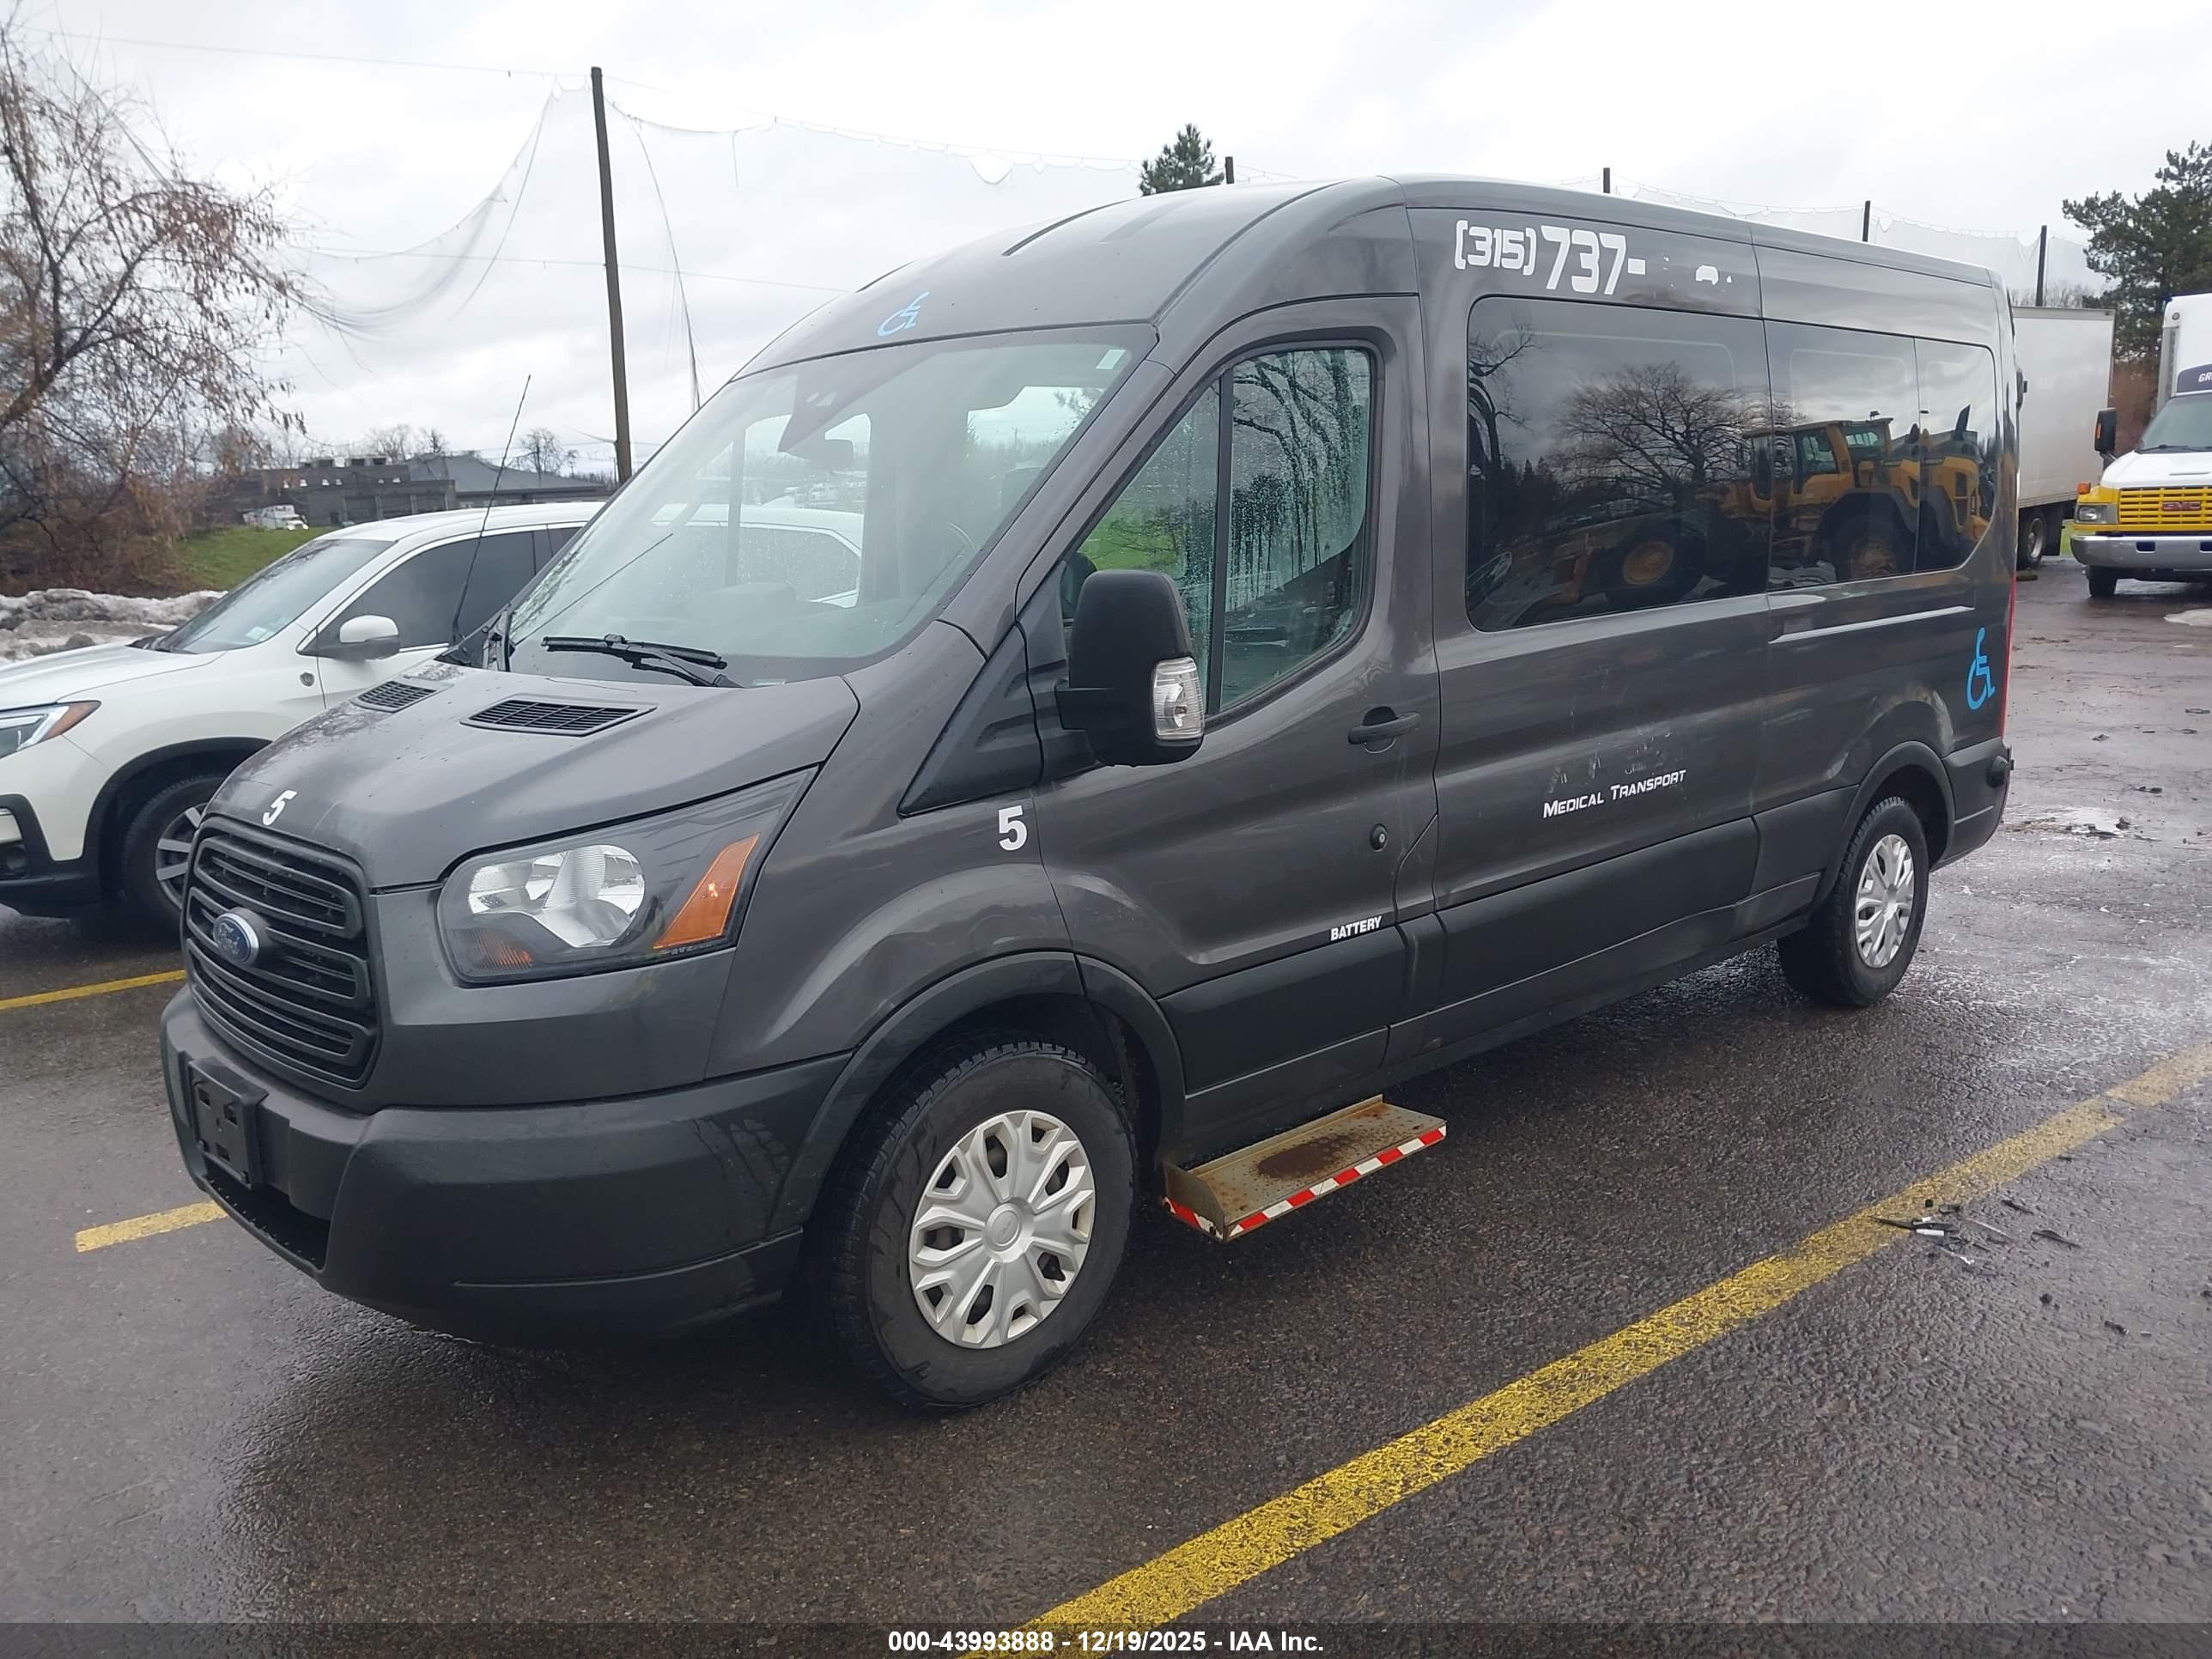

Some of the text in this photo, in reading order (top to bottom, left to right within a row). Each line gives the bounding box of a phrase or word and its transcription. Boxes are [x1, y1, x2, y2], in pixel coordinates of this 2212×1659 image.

[1454, 219, 1537, 276] (315)
[263, 789, 298, 826] 5
[998, 805, 1028, 851] 5
[1330, 915, 1382, 941] BATTERY
